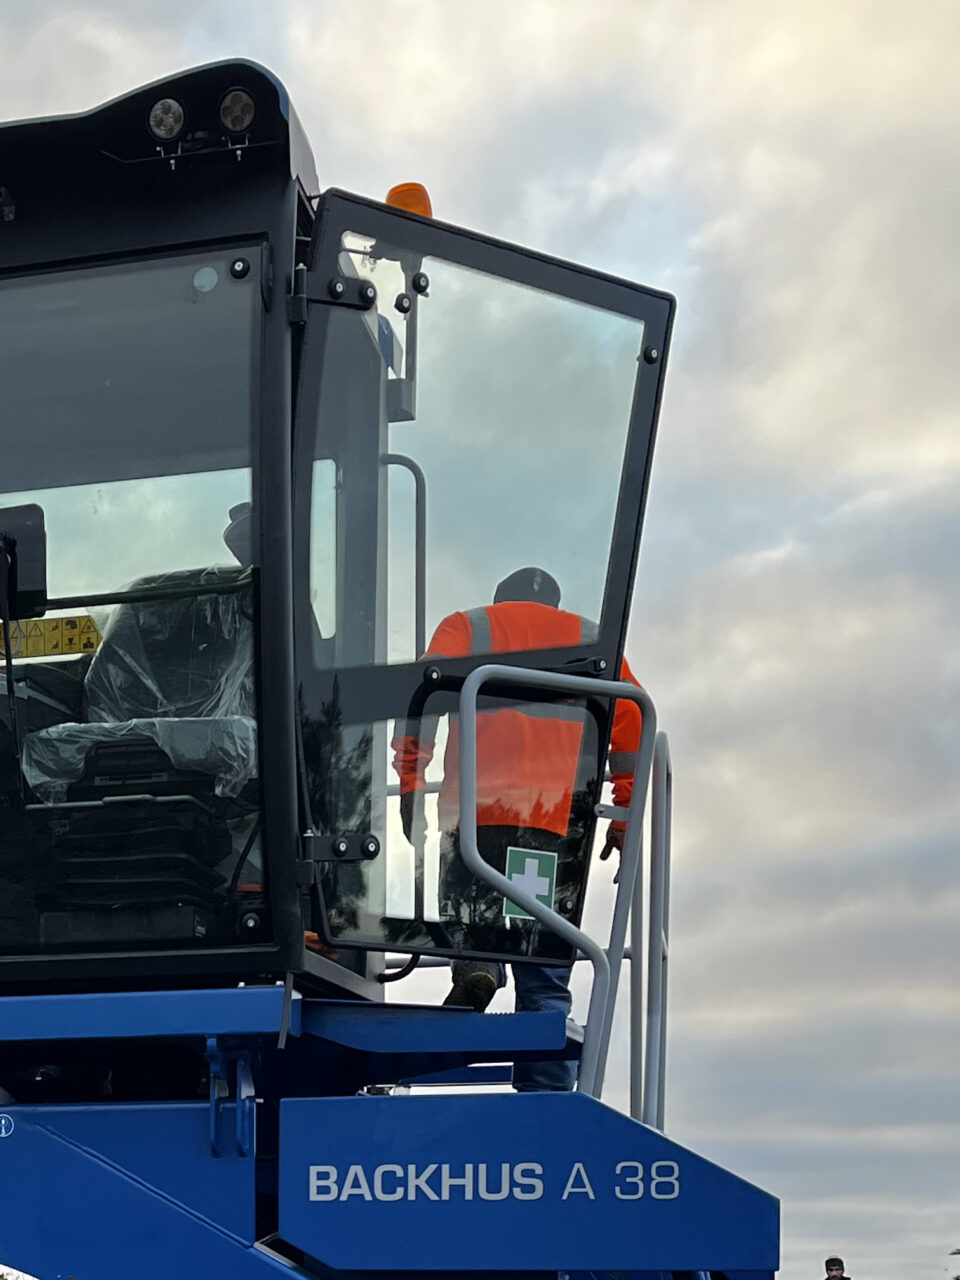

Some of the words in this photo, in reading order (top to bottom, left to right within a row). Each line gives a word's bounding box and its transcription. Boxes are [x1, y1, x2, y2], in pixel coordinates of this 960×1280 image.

[308, 1162, 544, 1202] BACKHUS
[561, 1162, 595, 1200] A
[614, 1160, 681, 1200] 38
